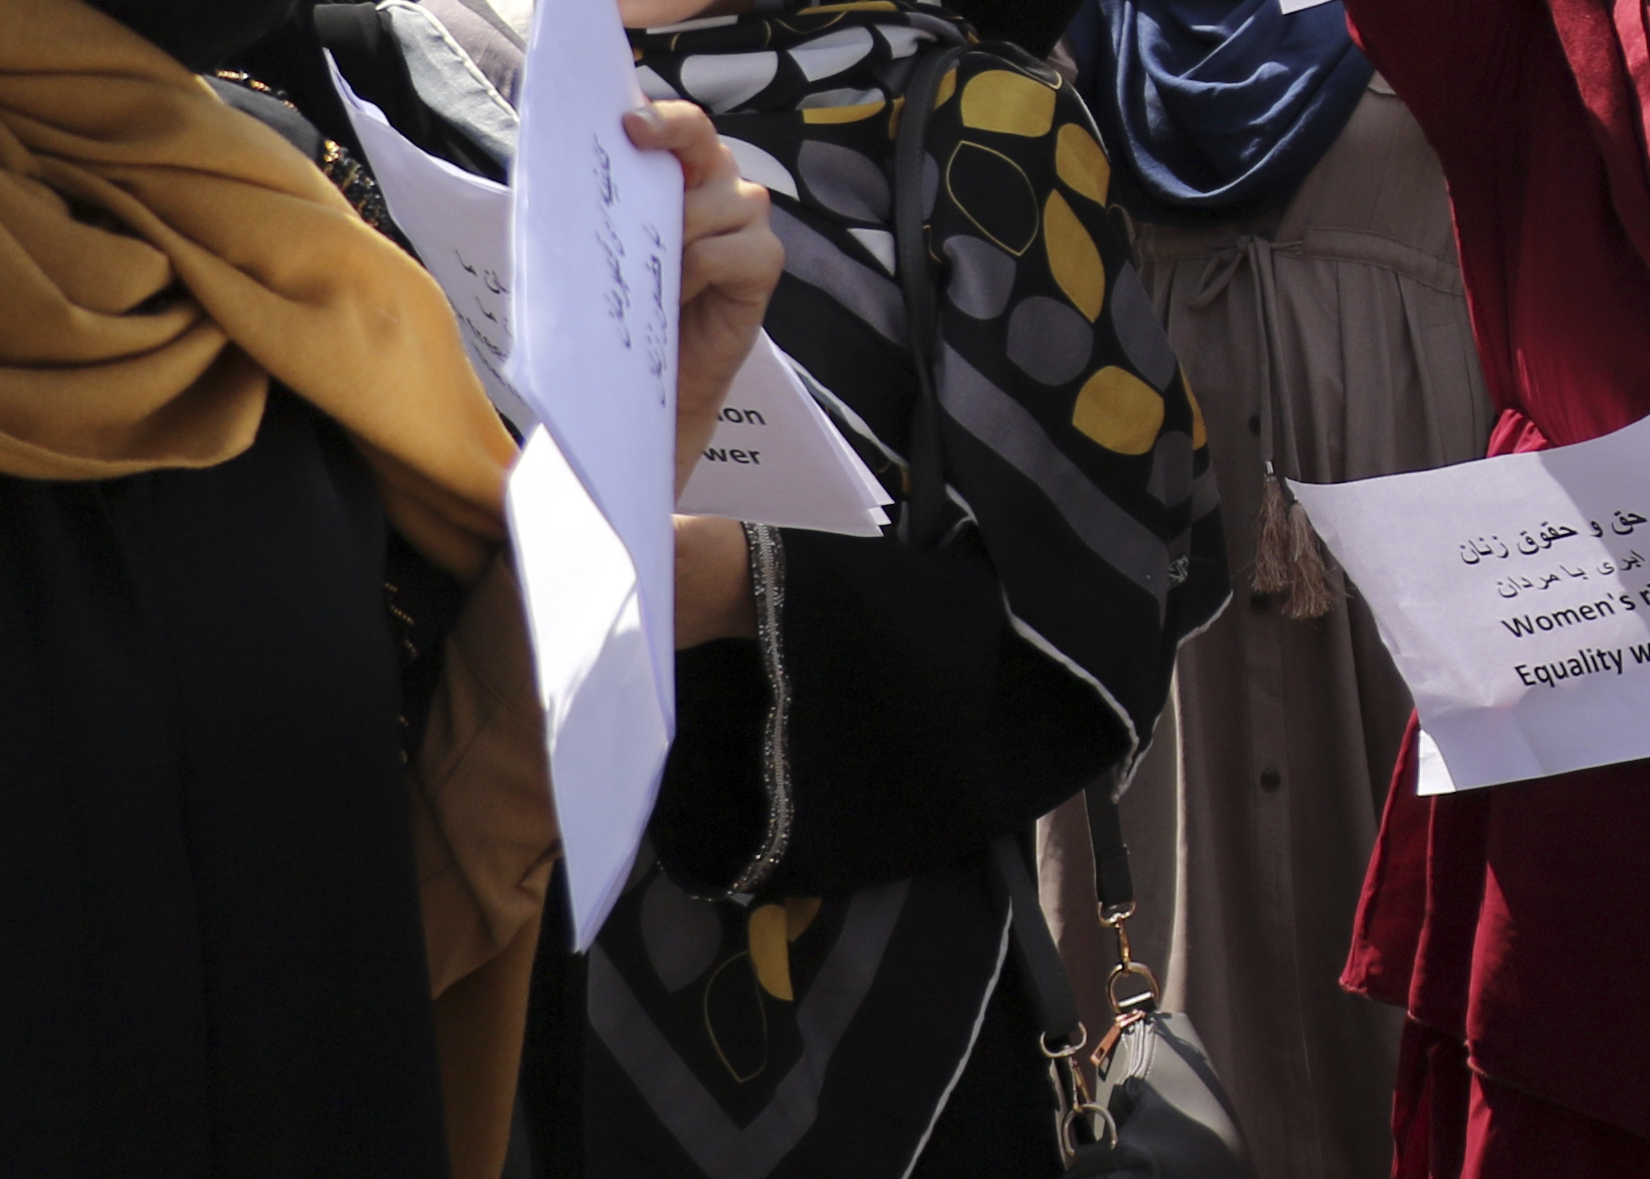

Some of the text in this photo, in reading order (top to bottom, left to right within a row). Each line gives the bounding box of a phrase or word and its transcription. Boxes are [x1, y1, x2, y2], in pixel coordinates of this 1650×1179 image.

[1460, 510, 1648, 565] حق و حقوق زنان
[1501, 593, 1636, 639] Women's
[1514, 648, 1624, 688] Equality
